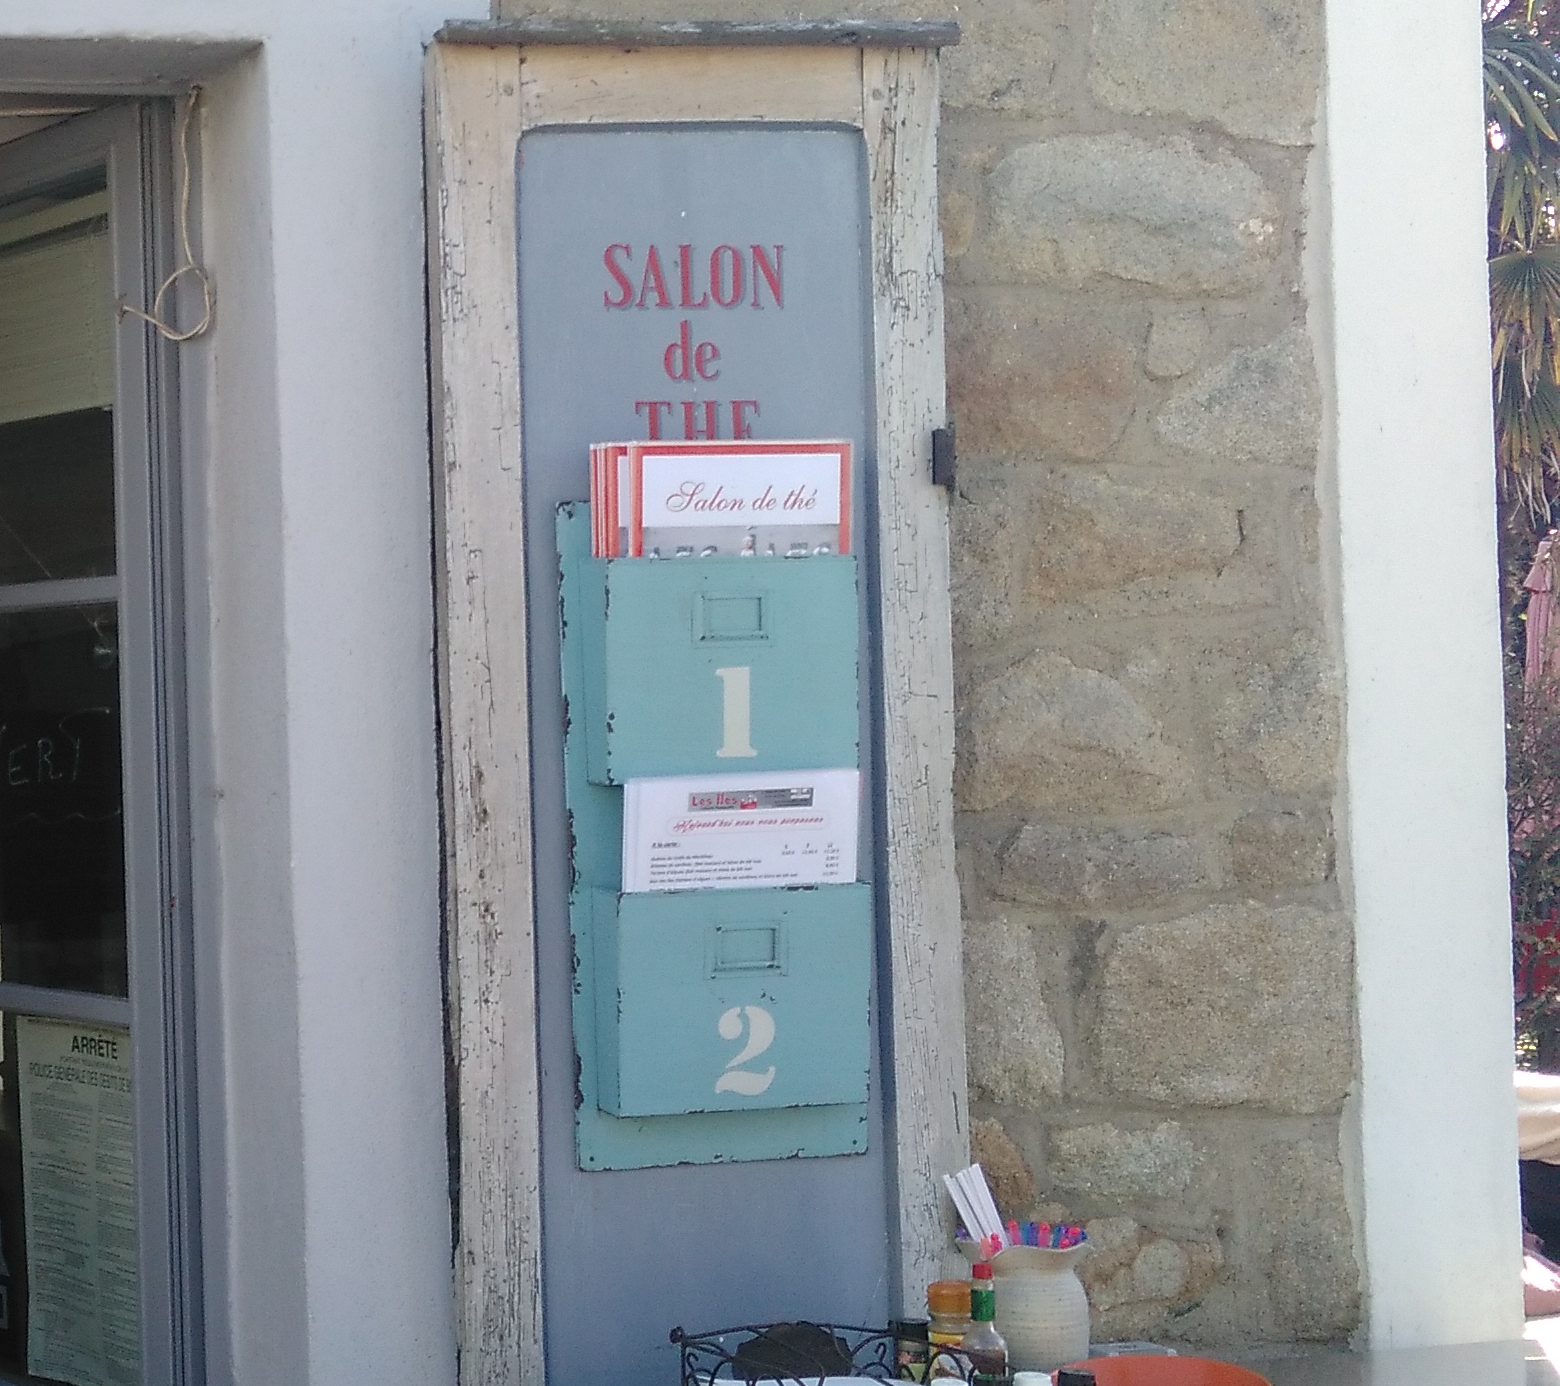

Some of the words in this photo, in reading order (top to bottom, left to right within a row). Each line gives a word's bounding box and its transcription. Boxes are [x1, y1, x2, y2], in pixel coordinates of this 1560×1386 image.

[602, 243, 785, 309] SALON
[662, 319, 720, 382] de
[665, 480, 745, 513] Salon
[751, 485, 778, 511] de
[782, 484, 819, 511] thé
[714, 665, 759, 759] 1
[714, 1005, 777, 1097] 2
